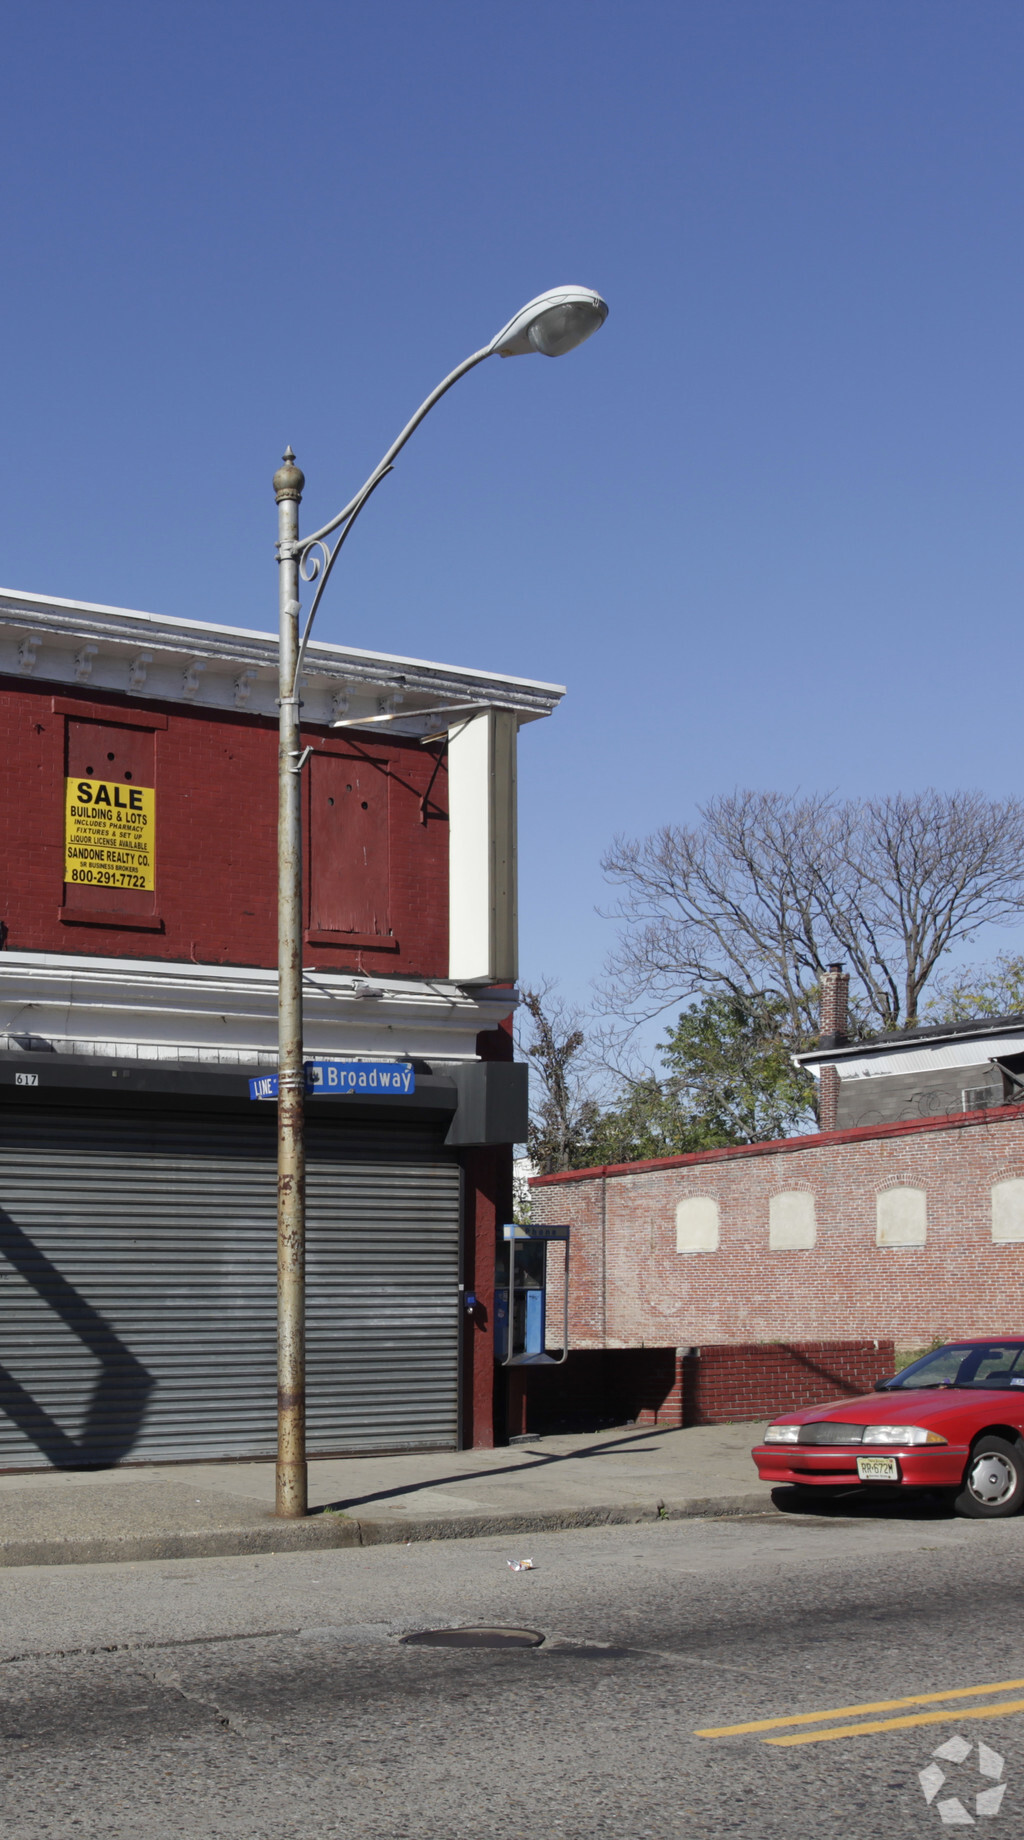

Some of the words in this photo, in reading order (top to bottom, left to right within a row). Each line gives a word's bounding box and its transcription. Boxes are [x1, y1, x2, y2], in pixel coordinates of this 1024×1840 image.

[77, 782, 143, 811] SALE
[70, 805, 113, 821] BUILDING
[116, 810, 122, 822] &
[126, 812, 148, 826] LOTS
[74, 819, 107, 828] INCLUDES
[109, 823, 144, 833] PHARMACY
[76, 827, 109, 836] FIXTURES
[70, 835, 92, 844] LIQUOR
[94, 837, 117, 847] LICENSE
[119, 840, 148, 850] AVAILABLE
[68, 847, 104, 861] SANDONE
[106, 851, 136, 865] REALTY
[138, 854, 150, 867] CO.
[88, 862, 114, 870] BUSINESS
[115, 864, 139, 873] BROKERS
[72, 868, 146, 888] 800-291-7722
[16, 1074, 37, 1086] 617
[254, 1078, 273, 1097] LINE
[328, 1066, 411, 1092] Broadway
[525, 1227, 556, 1236] Phone
